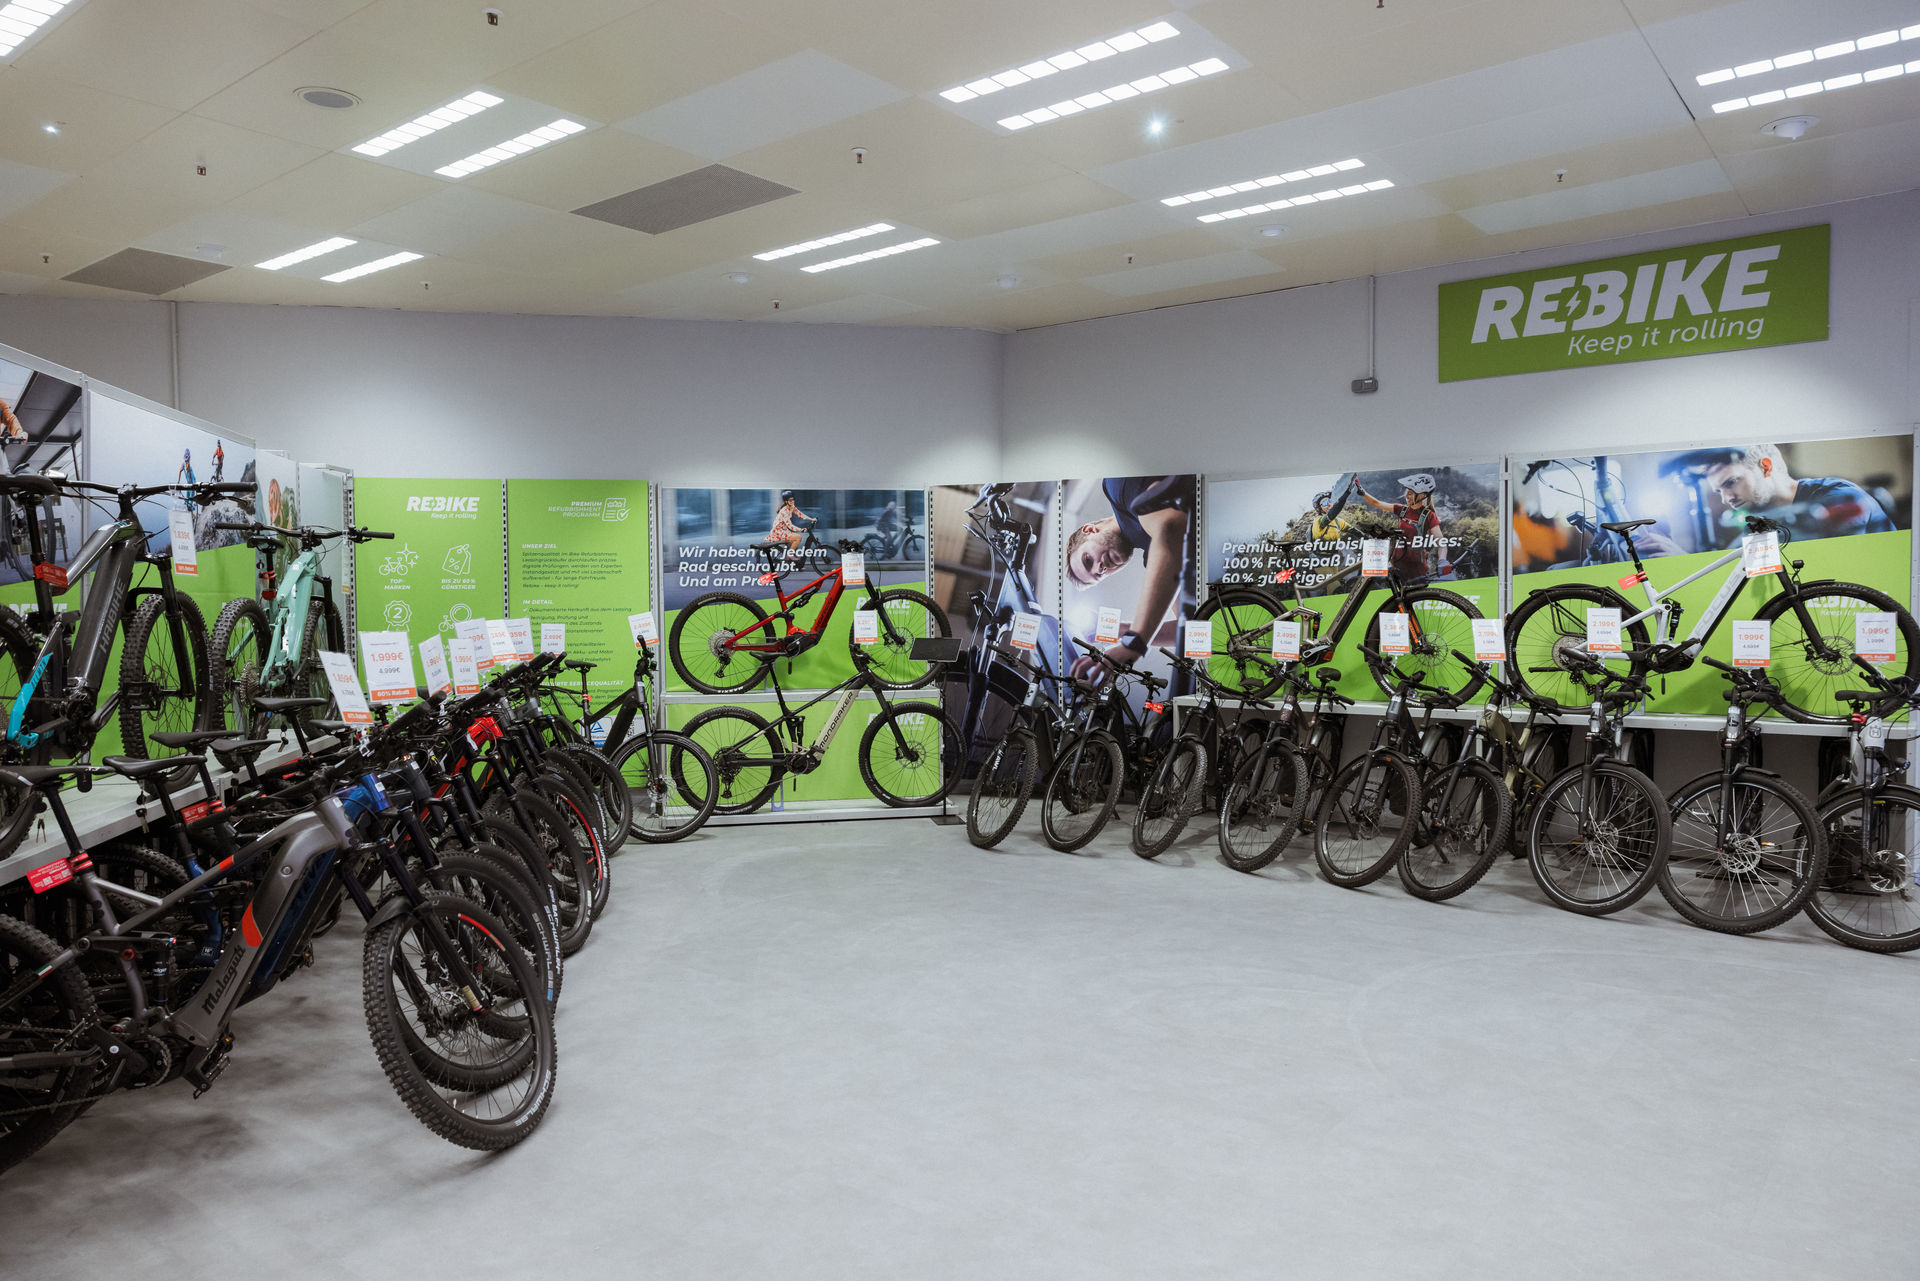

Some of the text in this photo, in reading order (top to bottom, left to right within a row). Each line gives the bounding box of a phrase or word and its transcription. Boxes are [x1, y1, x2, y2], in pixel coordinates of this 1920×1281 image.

[1471, 245, 1781, 344] REBIKE
[1568, 318, 1764, 356] Keep it rolling
[407, 496, 480, 512] REBIKE
[678, 561, 708, 572] Rad
[679, 547, 705, 558] Wir
[708, 546, 755, 558] haben
[781, 547, 827, 560] jedem
[679, 576, 709, 587] Und
[713, 578, 736, 587] am
[1692, 572, 1742, 638] FOCUS
[99, 579, 126, 654] HAIBIKE
[371, 652, 404, 662] 1.999€
[819, 691, 853, 750] MONDRAKER
[592, 827, 608, 878] SCHWALBE
[532, 912, 554, 990] SCHWALBE
[202, 944, 246, 1015] Malaguti
[515, 1069, 552, 1127] SCHWALBE
